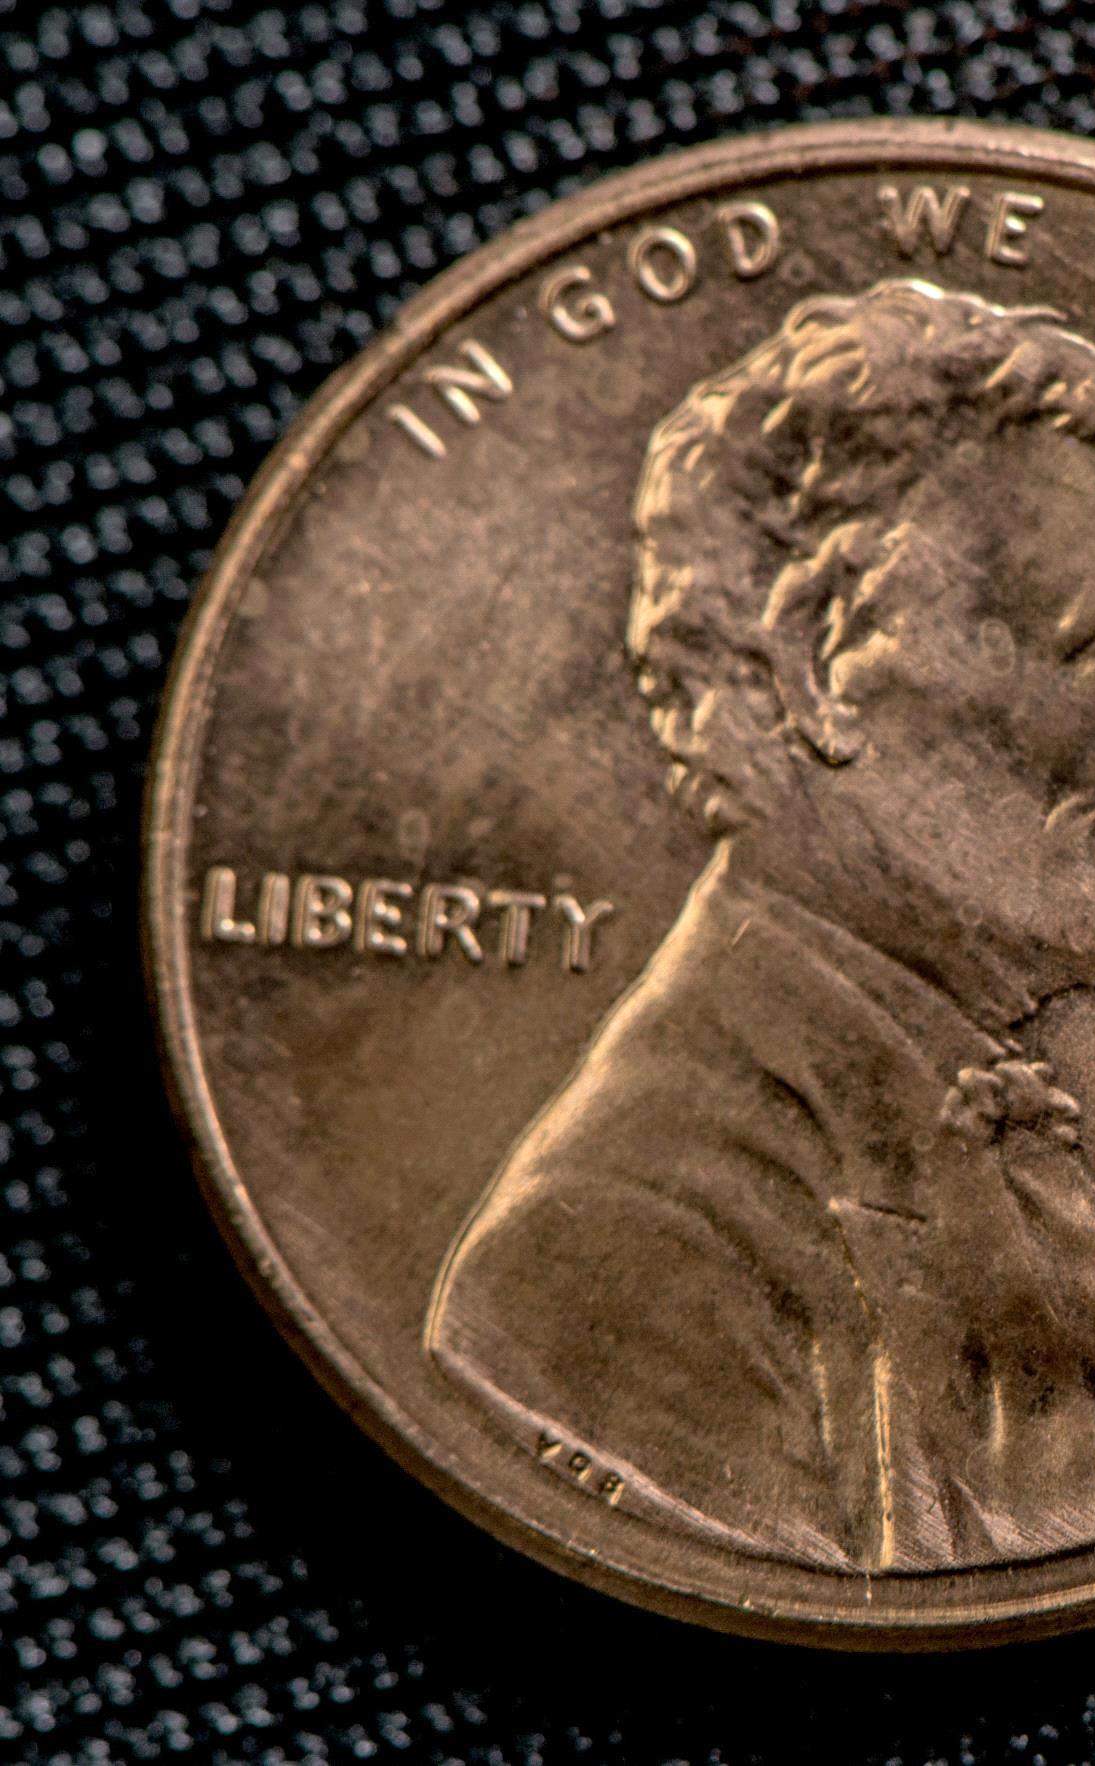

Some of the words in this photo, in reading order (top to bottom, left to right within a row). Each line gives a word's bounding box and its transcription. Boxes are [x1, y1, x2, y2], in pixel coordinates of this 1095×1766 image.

[388, 337, 514, 458] IN
[538, 200, 781, 342] GOD
[876, 184, 1045, 267] WE
[202, 865, 615, 973] LIBERTY
